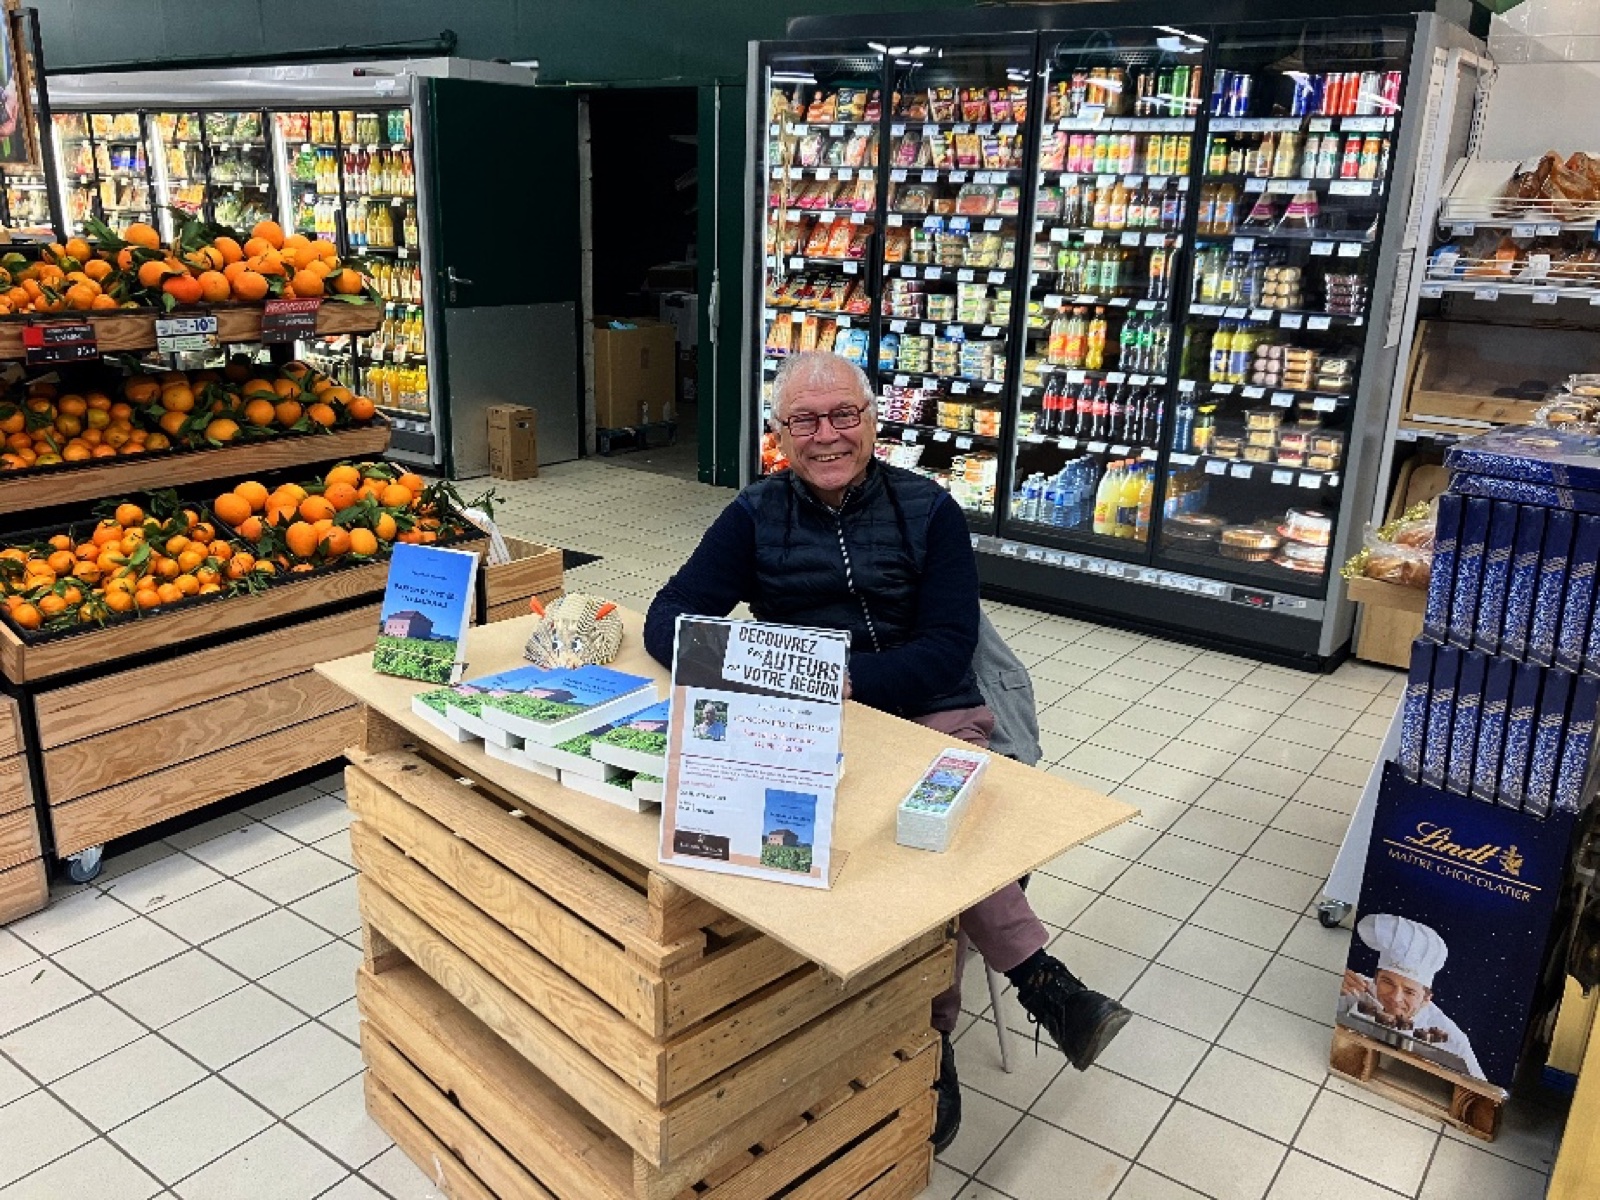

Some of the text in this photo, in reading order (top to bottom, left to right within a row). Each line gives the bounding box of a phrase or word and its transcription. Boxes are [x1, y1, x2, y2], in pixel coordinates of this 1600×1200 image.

[743, 664, 787, 688] VOTRE
[762, 649, 841, 681] AUTEURS
[1404, 821, 1502, 866] Lindt
[1436, 864, 1533, 903] CHOCOLATIER
